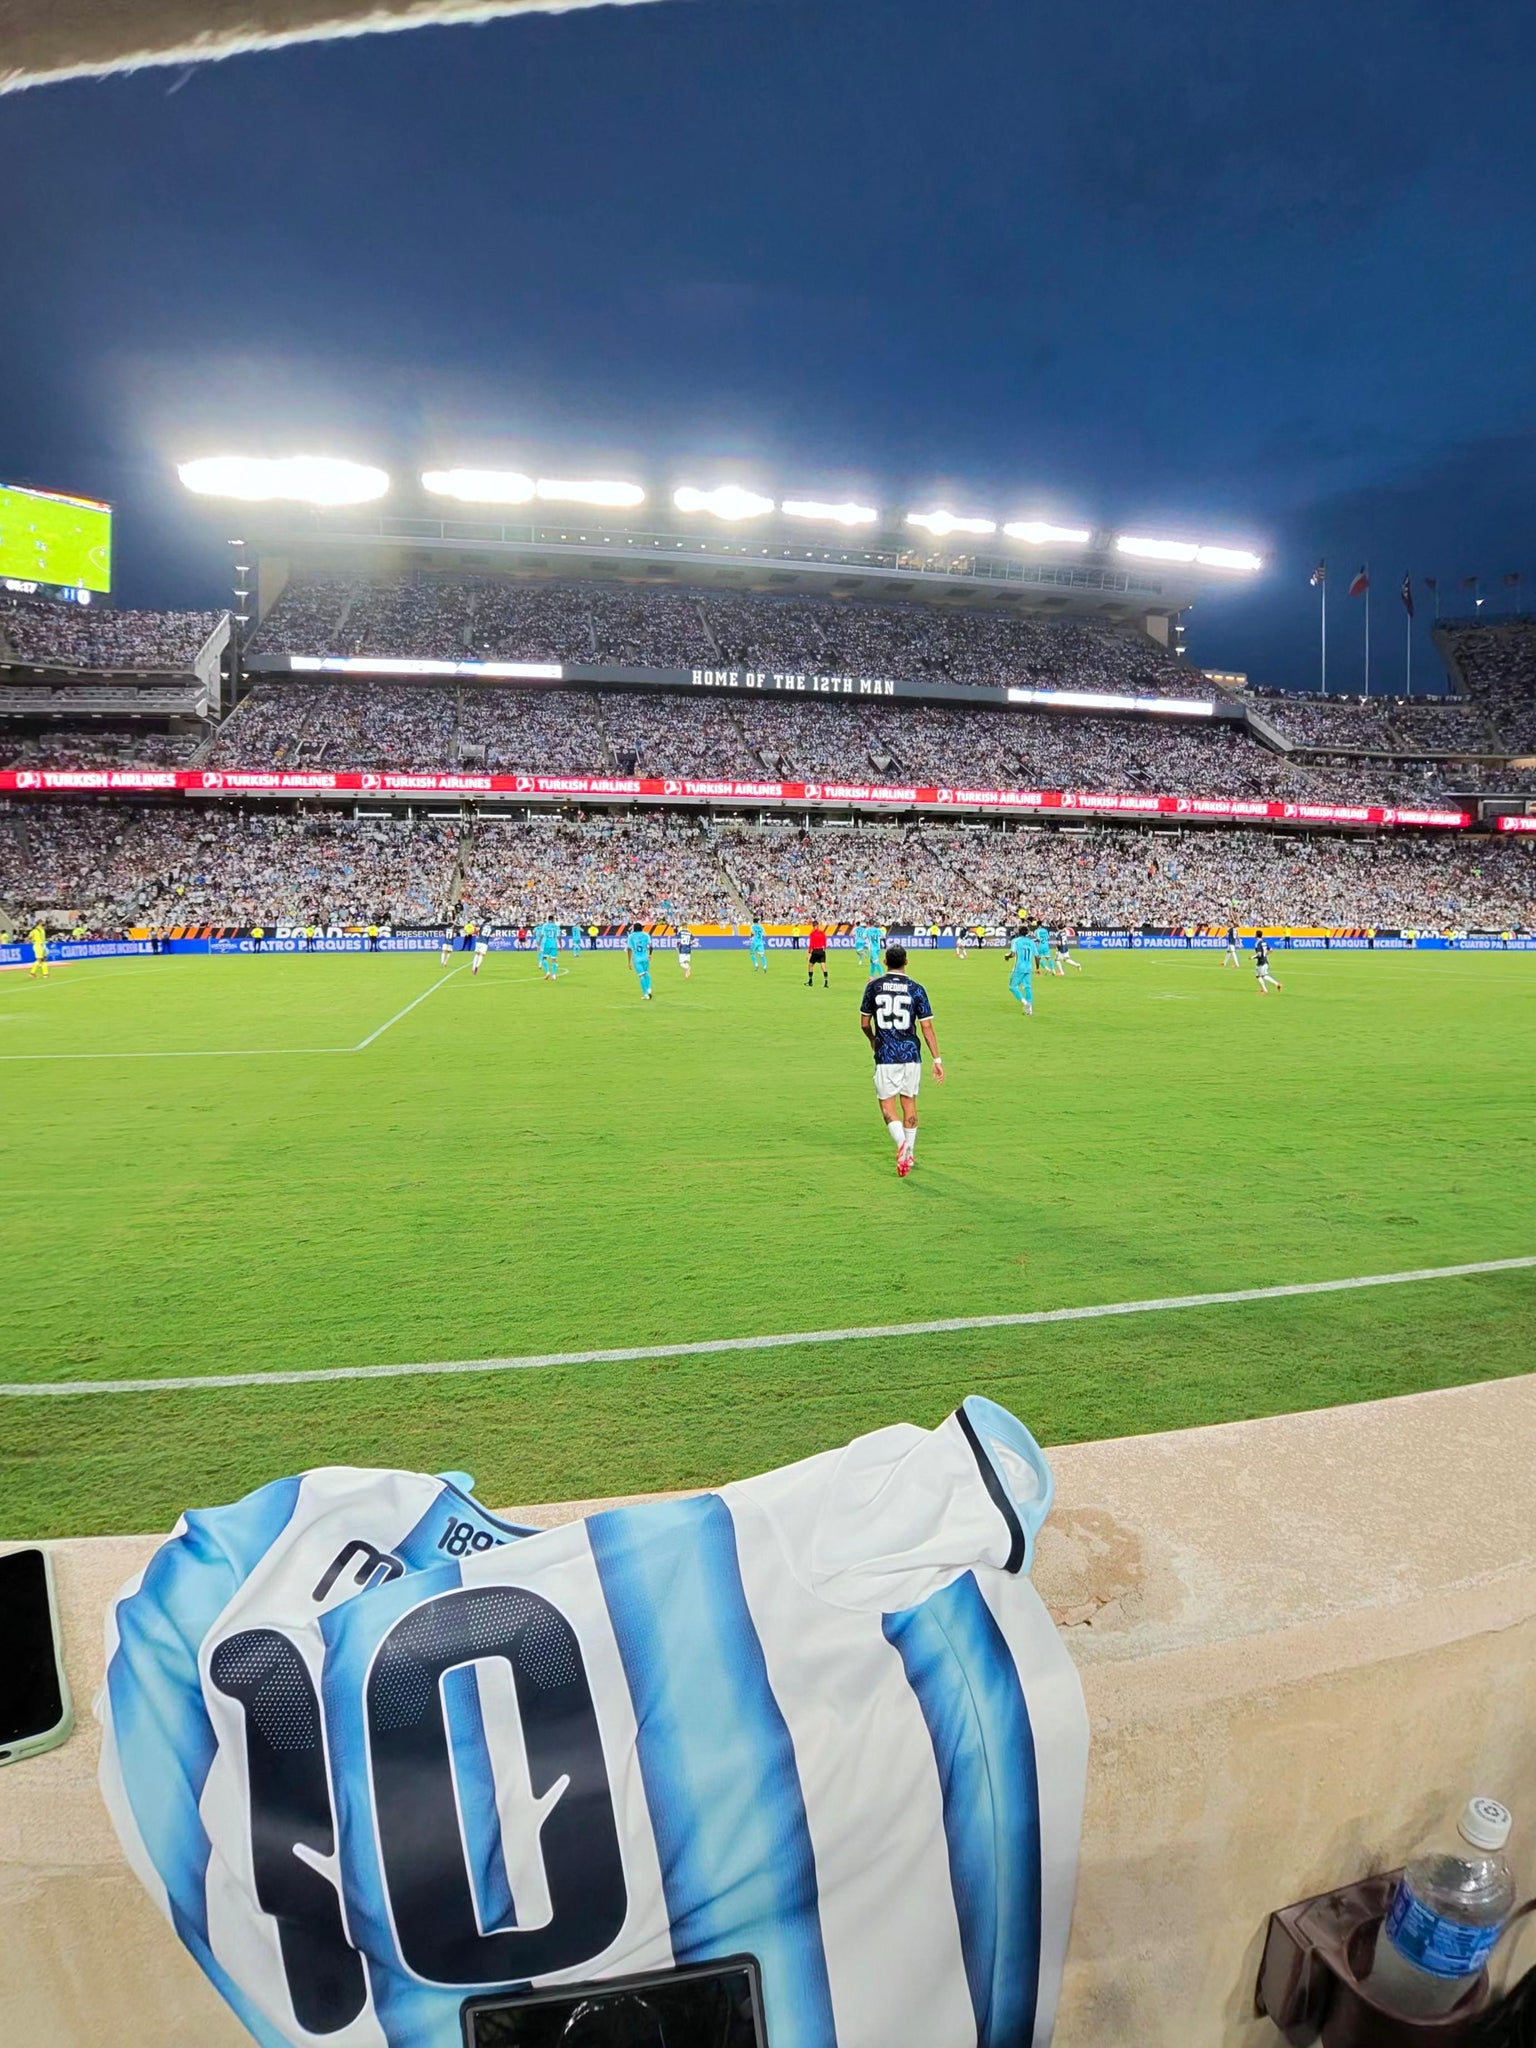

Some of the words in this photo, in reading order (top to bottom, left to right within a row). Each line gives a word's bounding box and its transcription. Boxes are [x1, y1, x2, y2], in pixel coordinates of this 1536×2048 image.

[692, 670, 738, 686] HOME
[746, 673, 765, 688] OF
[773, 675, 805, 690] THE
[813, 676, 853, 692] 12TH
[860, 679, 895, 695] MAN
[43, 773, 108, 788] TURKISH
[110, 773, 175, 788] AIRLINES
[226, 774, 279, 787] TURKISH
[281, 775, 336, 787] AIRLINES
[384, 777, 436, 789] TURKISH
[438, 777, 492, 789] AIRLINES
[538, 779, 588, 791] TURKISH
[590, 780, 641, 792] AIRLINES
[685, 783, 733, 795] TURKISH
[735, 784, 783, 796] AIRLINES
[824, 787, 870, 799] TURKISH
[871, 788, 917, 800] AIRLINES
[956, 791, 998, 803] TURKISH
[1000, 793, 1042, 804] AIRLINES
[1079, 796, 1118, 807] TURKISH
[1120, 797, 1159, 809] AIRLINES
[1193, 801, 1229, 812] TURKISH
[1231, 803, 1268, 814] AIRLINES
[1299, 806, 1333, 817] TURKISH
[1334, 808, 1369, 820] AIRLINES
[1398, 811, 1428, 823] TURKISH
[1430, 813, 1461, 825] AIRLINES
[276, 927, 342, 938] ROAD
[364, 938, 442, 950] ICREÍBLES.
[966, 938, 987, 947] OAD
[1102, 938, 1142, 948] CUATO
[875, 994, 912, 1030] 25
[438, 1516, 507, 1557] 189
[208, 1584, 629, 2036] 10
